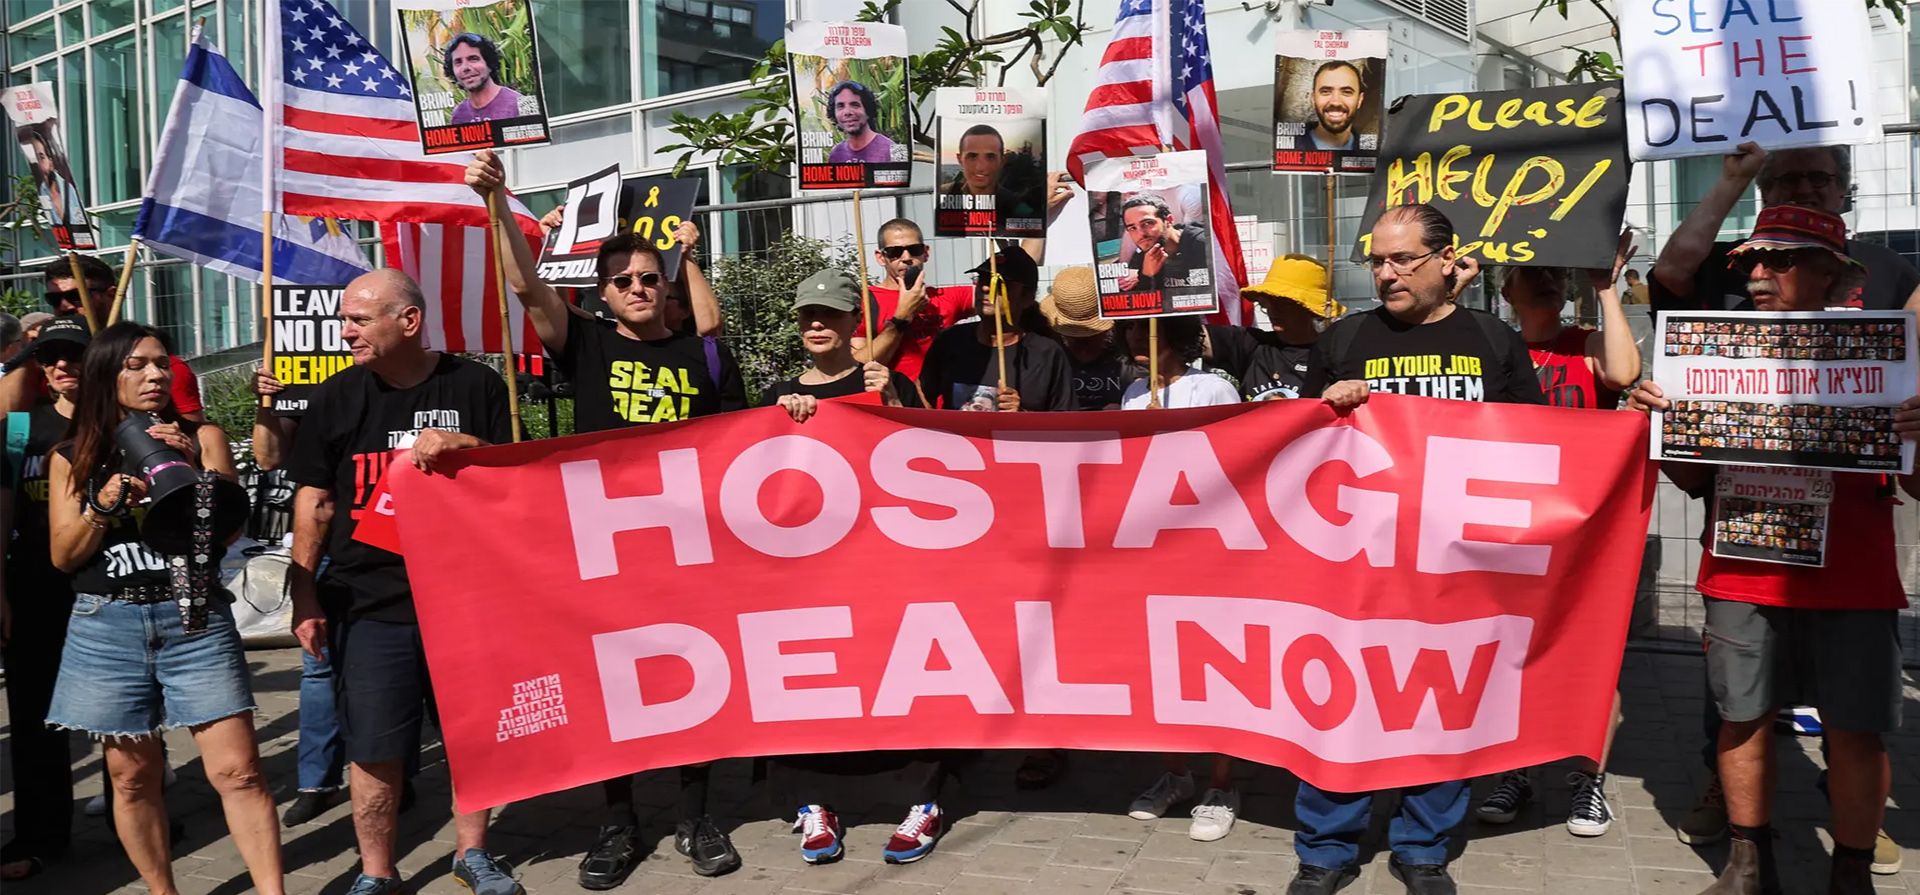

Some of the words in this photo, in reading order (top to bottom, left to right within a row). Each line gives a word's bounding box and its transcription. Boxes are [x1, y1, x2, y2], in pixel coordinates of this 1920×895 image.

[1652, 0, 1803, 35] SEAL
[1682, 36, 1817, 77] THE
[419, 91, 455, 110] BRING
[422, 109, 446, 128] HIM
[1428, 95, 1608, 132] Please
[425, 126, 458, 147] HOME
[461, 122, 493, 143] NOW!
[801, 131, 834, 147] BRING
[1277, 122, 1306, 136] BRING
[1277, 136, 1295, 150] HIM
[802, 147, 823, 164] HIM
[1276, 151, 1303, 165] HOME
[1305, 151, 1333, 165] NOW!
[802, 165, 834, 181] HOME
[835, 164, 865, 181] NOW!
[552, 171, 619, 255] כן
[940, 194, 973, 210] BRING
[975, 194, 996, 210] HIM
[969, 211, 997, 226] NOW!
[618, 215, 682, 250] OS
[1098, 262, 1129, 278] BRING
[1100, 278, 1120, 294] HIM
[273, 289, 346, 316] LEAV
[1103, 294, 1131, 310] HOME
[1132, 290, 1163, 308] NOW!
[274, 319, 315, 352] NO
[609, 360, 699, 395] SEAL
[1365, 357, 1389, 379] DO
[1392, 355, 1443, 376] YOUR
[1445, 355, 1482, 376] JOB
[1252, 382, 1274, 394] TAL
[1367, 377, 1410, 395] GET
[1415, 376, 1485, 402] THEM
[1686, 367, 1768, 395] מהגיהנום!
[1776, 367, 1818, 395] אותם
[1826, 366, 1884, 394] תוציאו
[560, 425, 1561, 581] HOSTAGE
[1734, 483, 1807, 501] מהגיהנום
[512, 673, 561, 694] מחאת
[591, 601, 1132, 742] DEAL
[1175, 620, 1501, 732] NOW
[512, 683, 563, 706] הנשים
[498, 703, 567, 732] החטופות
[500, 694, 564, 721] להחזרת
[496, 714, 569, 743] והחטופים
